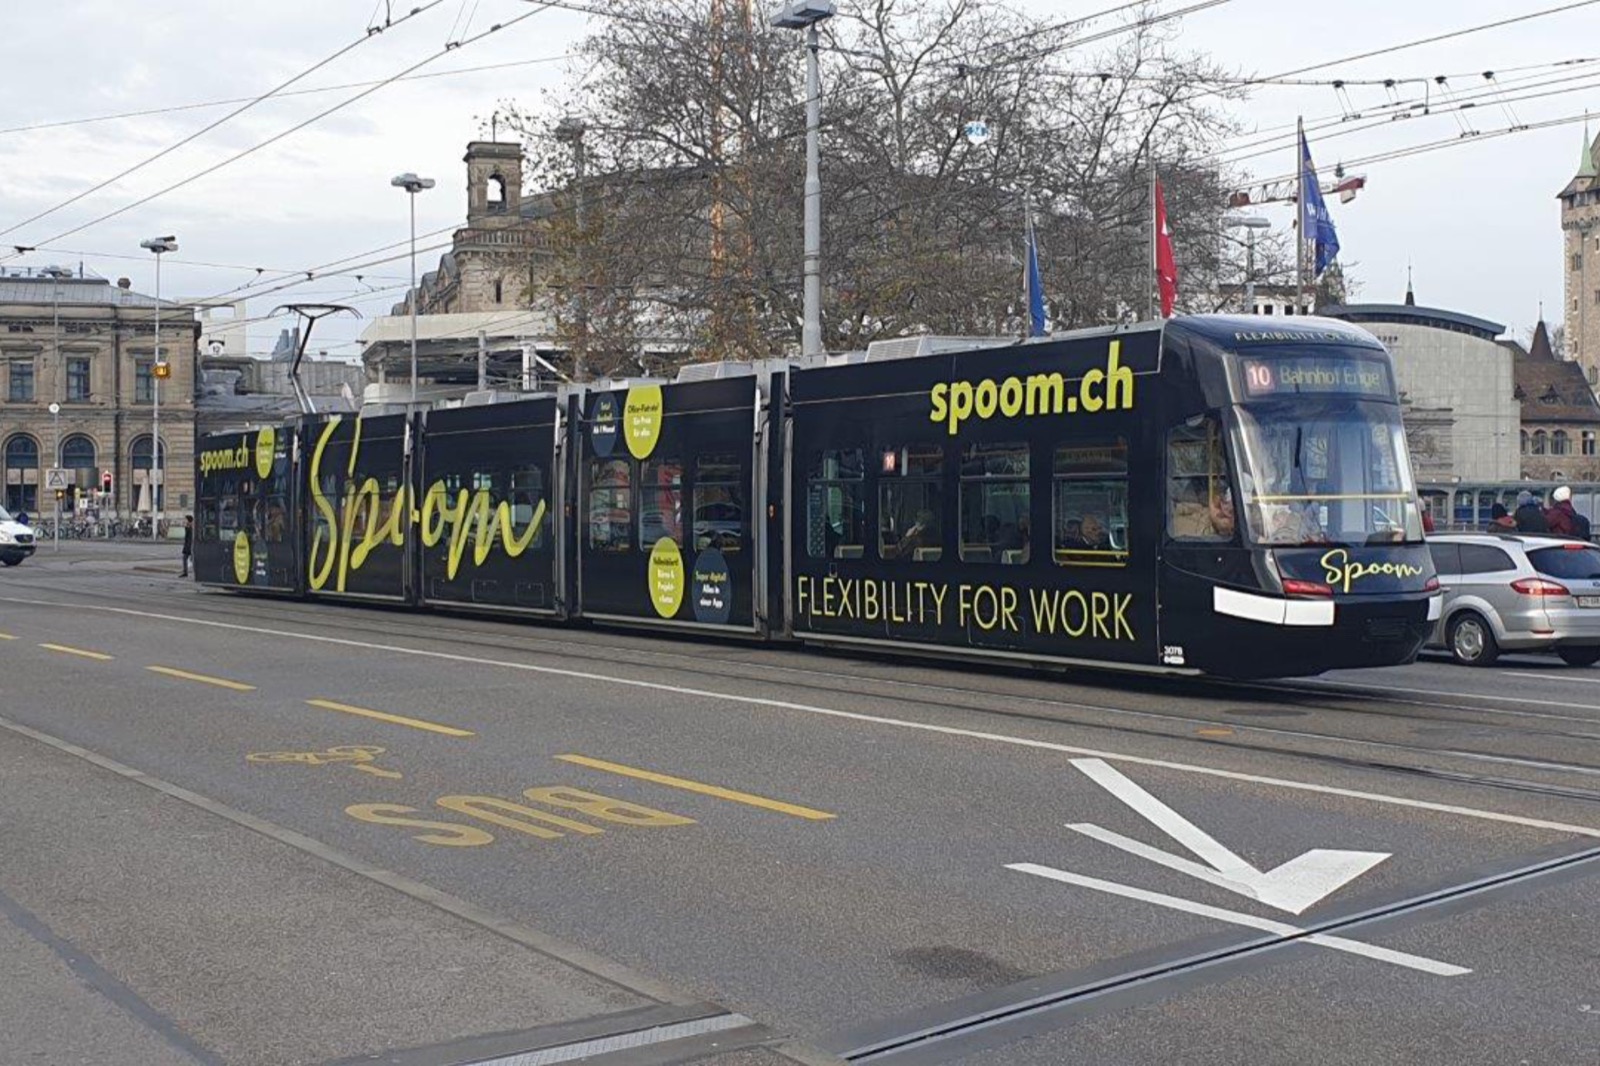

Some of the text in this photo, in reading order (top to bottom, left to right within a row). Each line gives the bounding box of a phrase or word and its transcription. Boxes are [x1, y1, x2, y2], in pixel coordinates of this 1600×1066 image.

[1235, 331, 1315, 341] FLEXIBILITY
[930, 340, 1134, 434] spoom.ch
[1249, 365, 1271, 386] 10
[1280, 364, 1339, 385] Bahnhof
[200, 434, 248, 477] spoom.ch
[309, 416, 546, 593] Spoom
[1320, 549, 1422, 593] Spoom
[798, 576, 1136, 641] FLEXIBILITY FOR WORK
[344, 786, 698, 846] BUS
